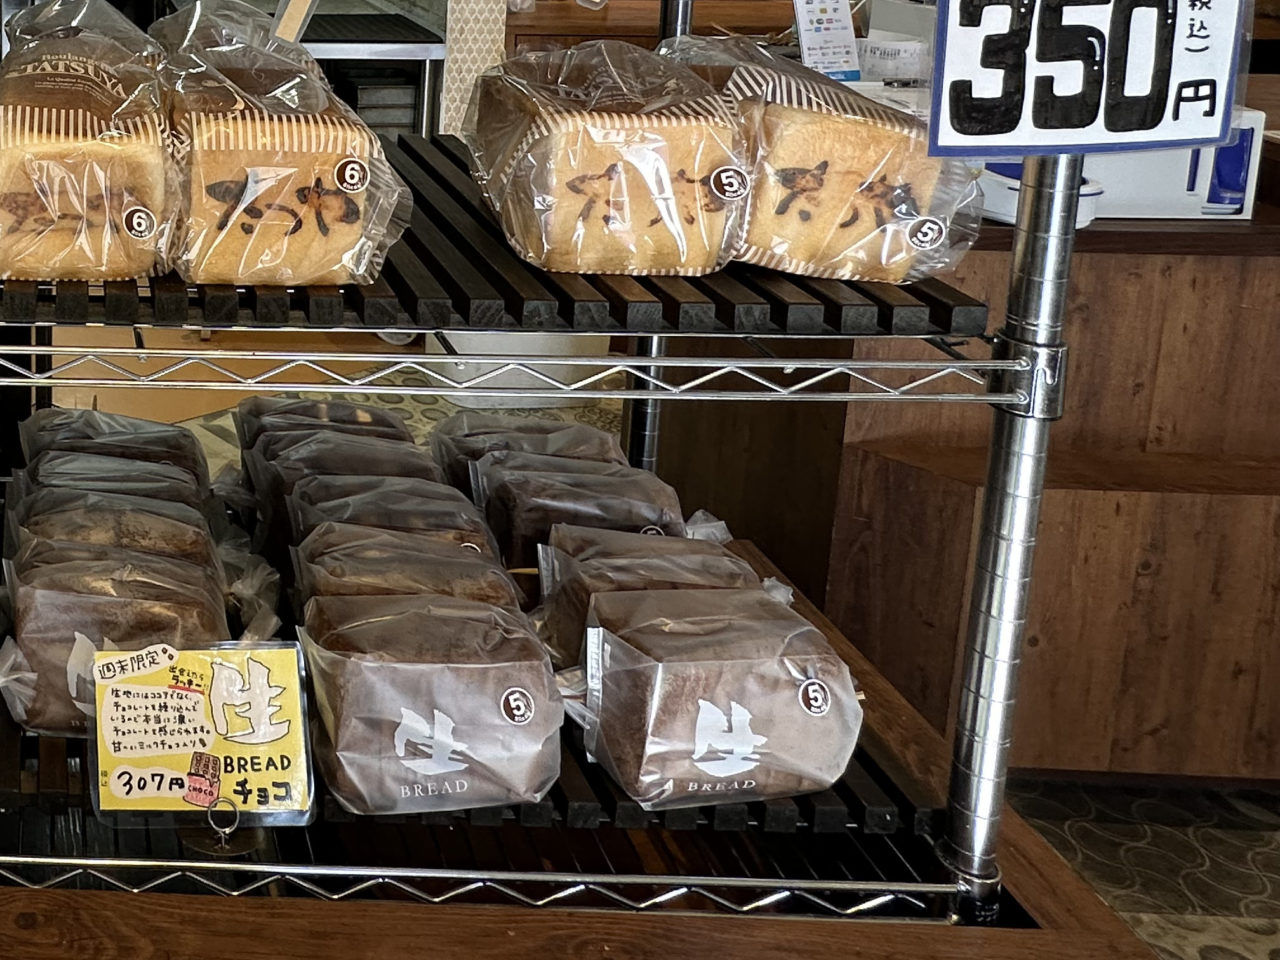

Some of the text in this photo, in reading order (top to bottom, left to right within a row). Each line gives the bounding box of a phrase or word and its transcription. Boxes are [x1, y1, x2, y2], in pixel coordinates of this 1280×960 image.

[21, 60, 128, 100] TATSUYA
[344, 162, 361, 184] 6
[132, 211, 147, 232] 6
[98, 650, 160, 680] 週末限定
[223, 755, 292, 774] BREAD
[117, 770, 185, 796] 307円
[187, 784, 215, 797] CHOCO
[233, 778, 293, 806] チョコ
[399, 779, 468, 799] BREAD
[687, 779, 757, 793] BREAD
